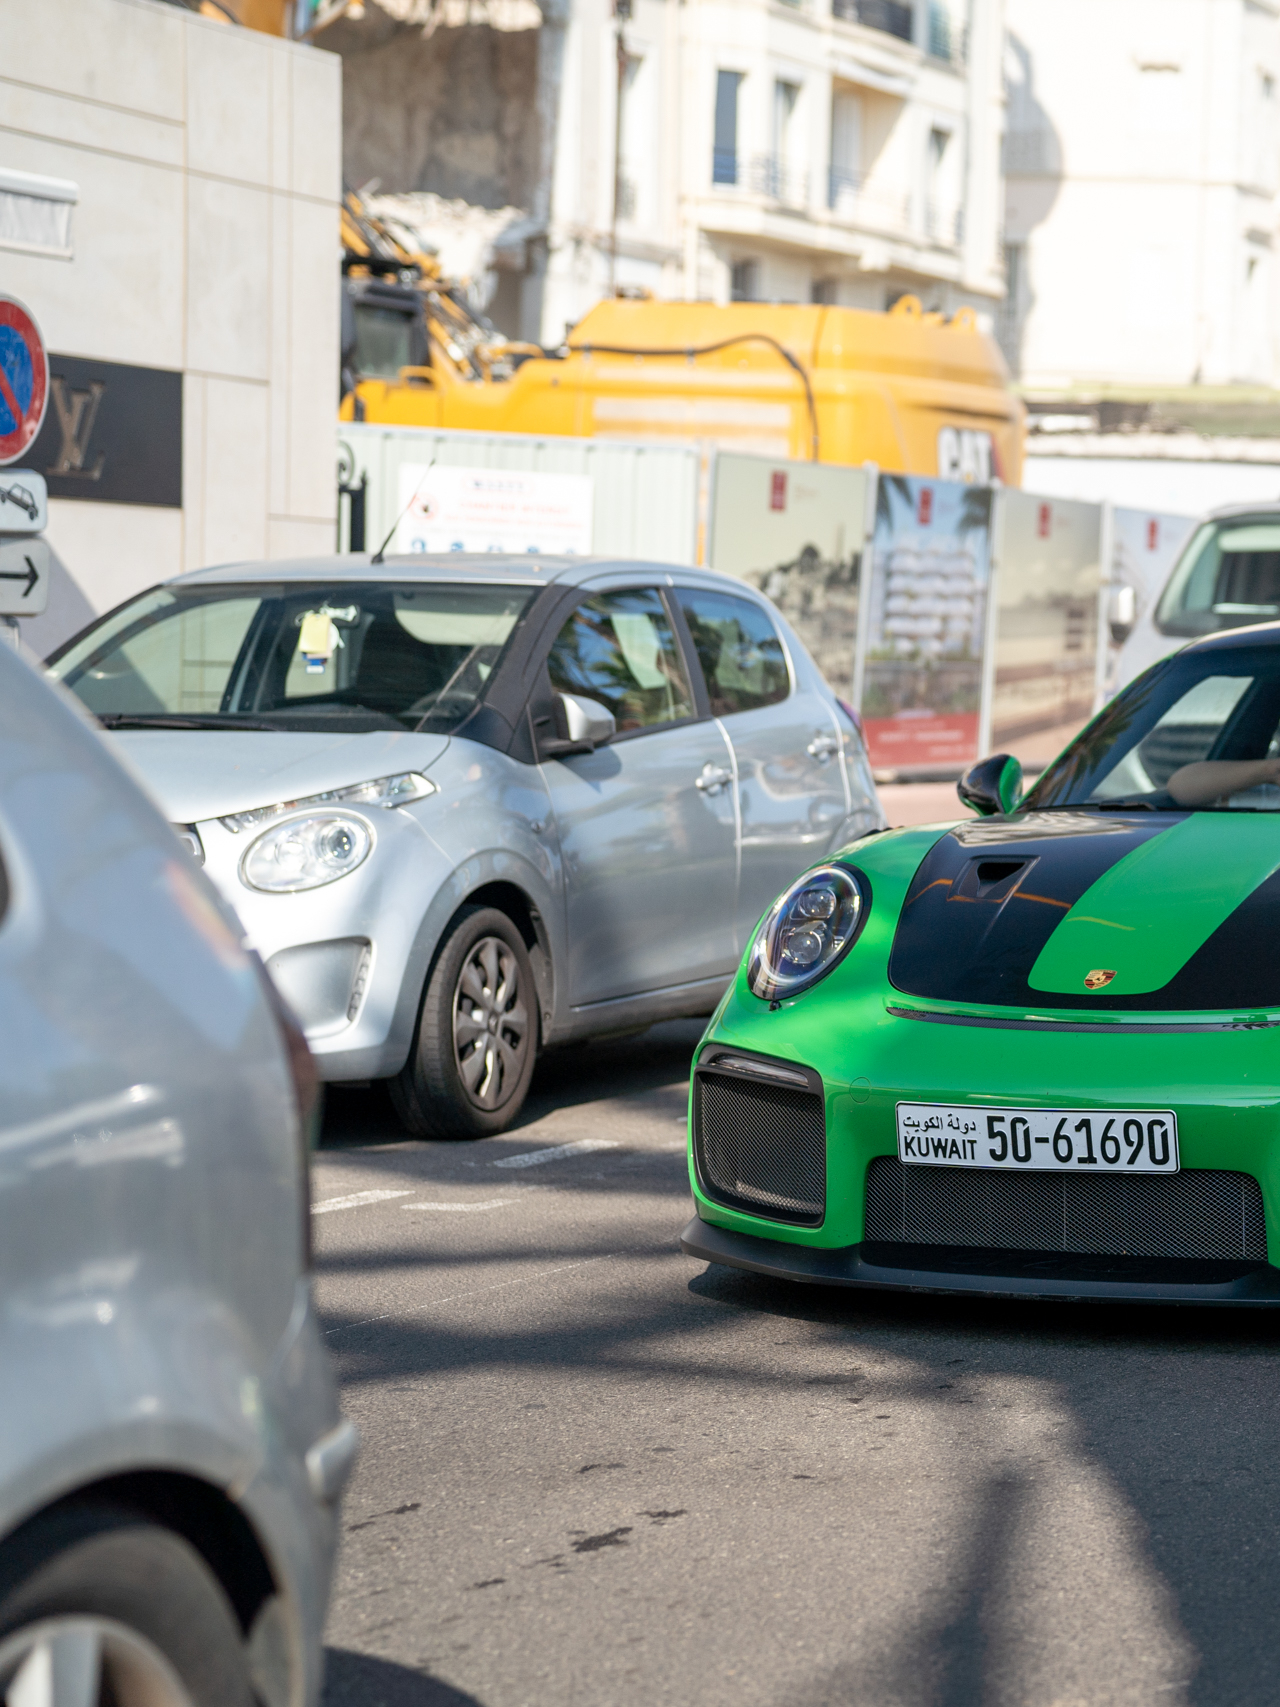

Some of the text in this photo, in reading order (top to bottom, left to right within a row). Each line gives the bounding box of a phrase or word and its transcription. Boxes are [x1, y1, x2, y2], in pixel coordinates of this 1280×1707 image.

[938, 426, 991, 485] CAT
[903, 1113, 976, 1134] دولة الكويت
[986, 1115, 1170, 1165] 50-61690
[904, 1136, 977, 1160] KUWAIT
